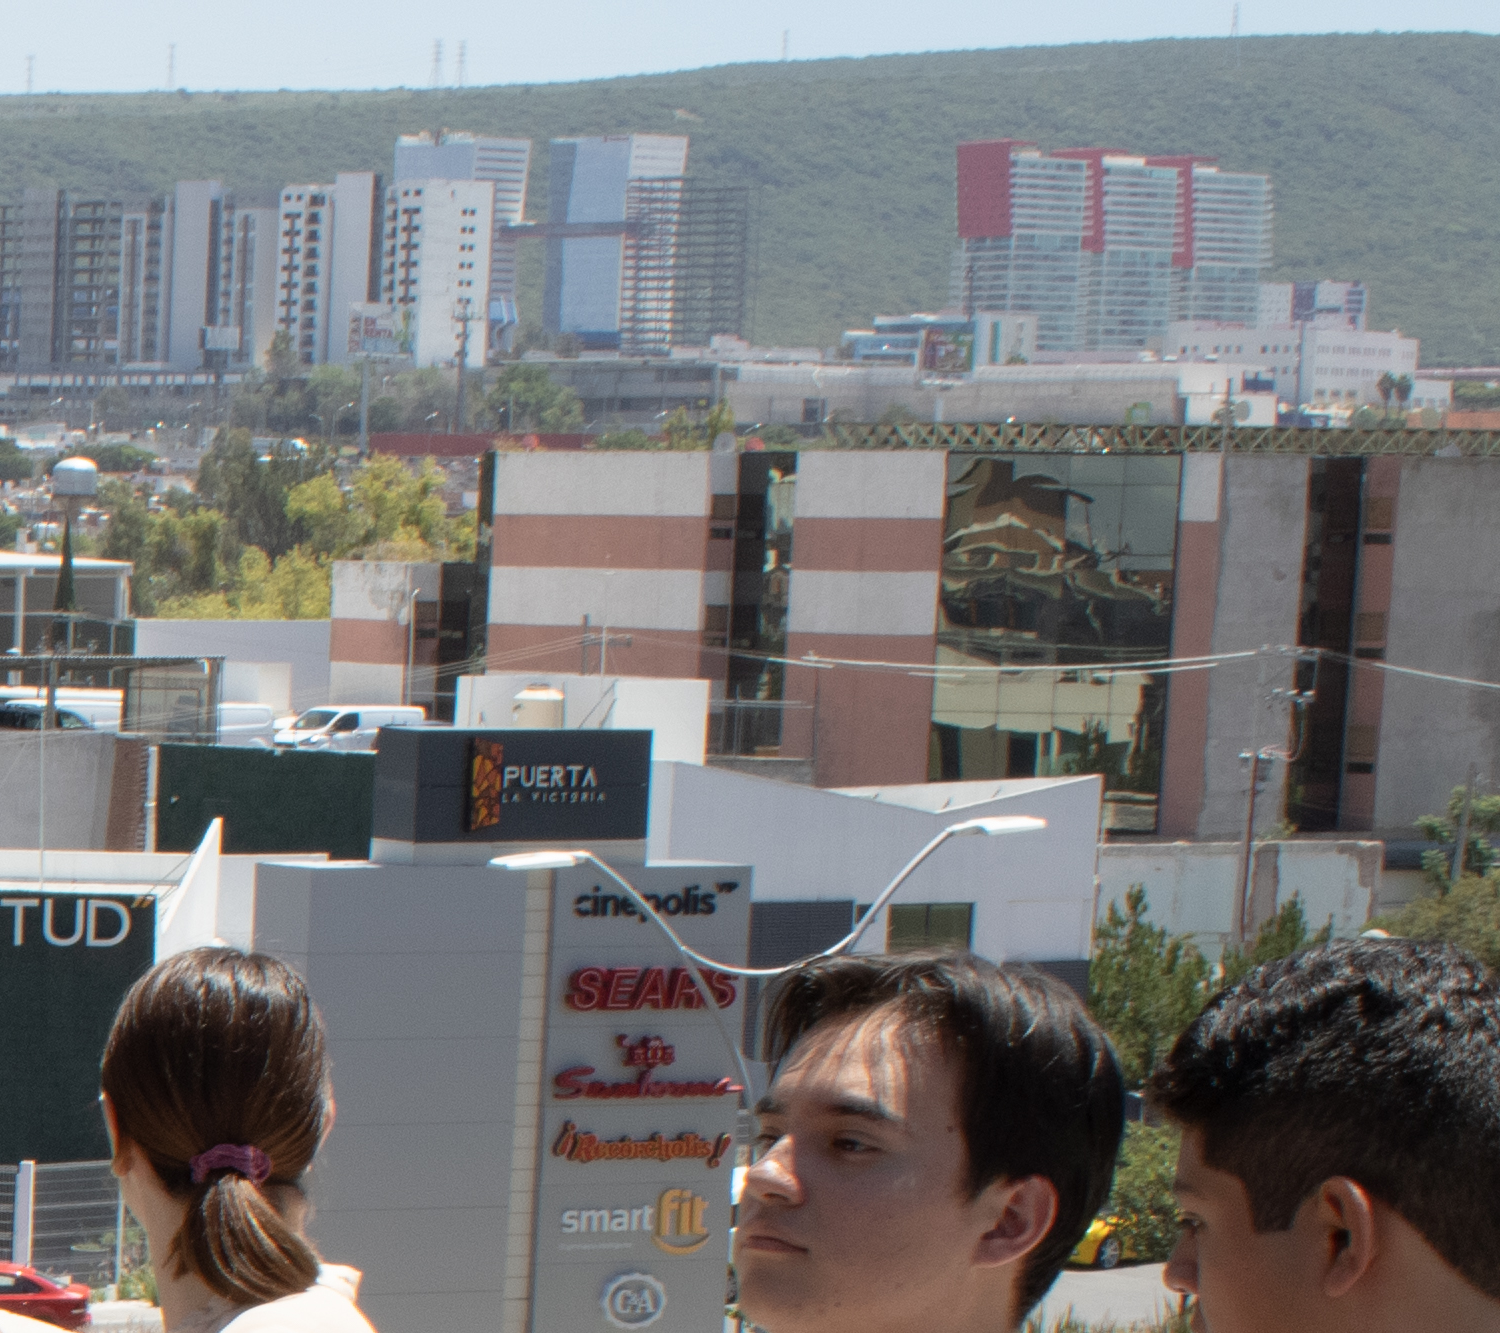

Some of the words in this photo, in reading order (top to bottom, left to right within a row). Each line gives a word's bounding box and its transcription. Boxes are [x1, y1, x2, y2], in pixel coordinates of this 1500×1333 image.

[503, 765, 598, 788] PUERTA
[501, 792, 522, 803] LA
[531, 792, 606, 804] VICTORIA
[567, 966, 739, 1012] SEARS
[562, 1205, 654, 1234] smart
[657, 1188, 709, 1237] fit
[613, 1288, 656, 1314] C&A
